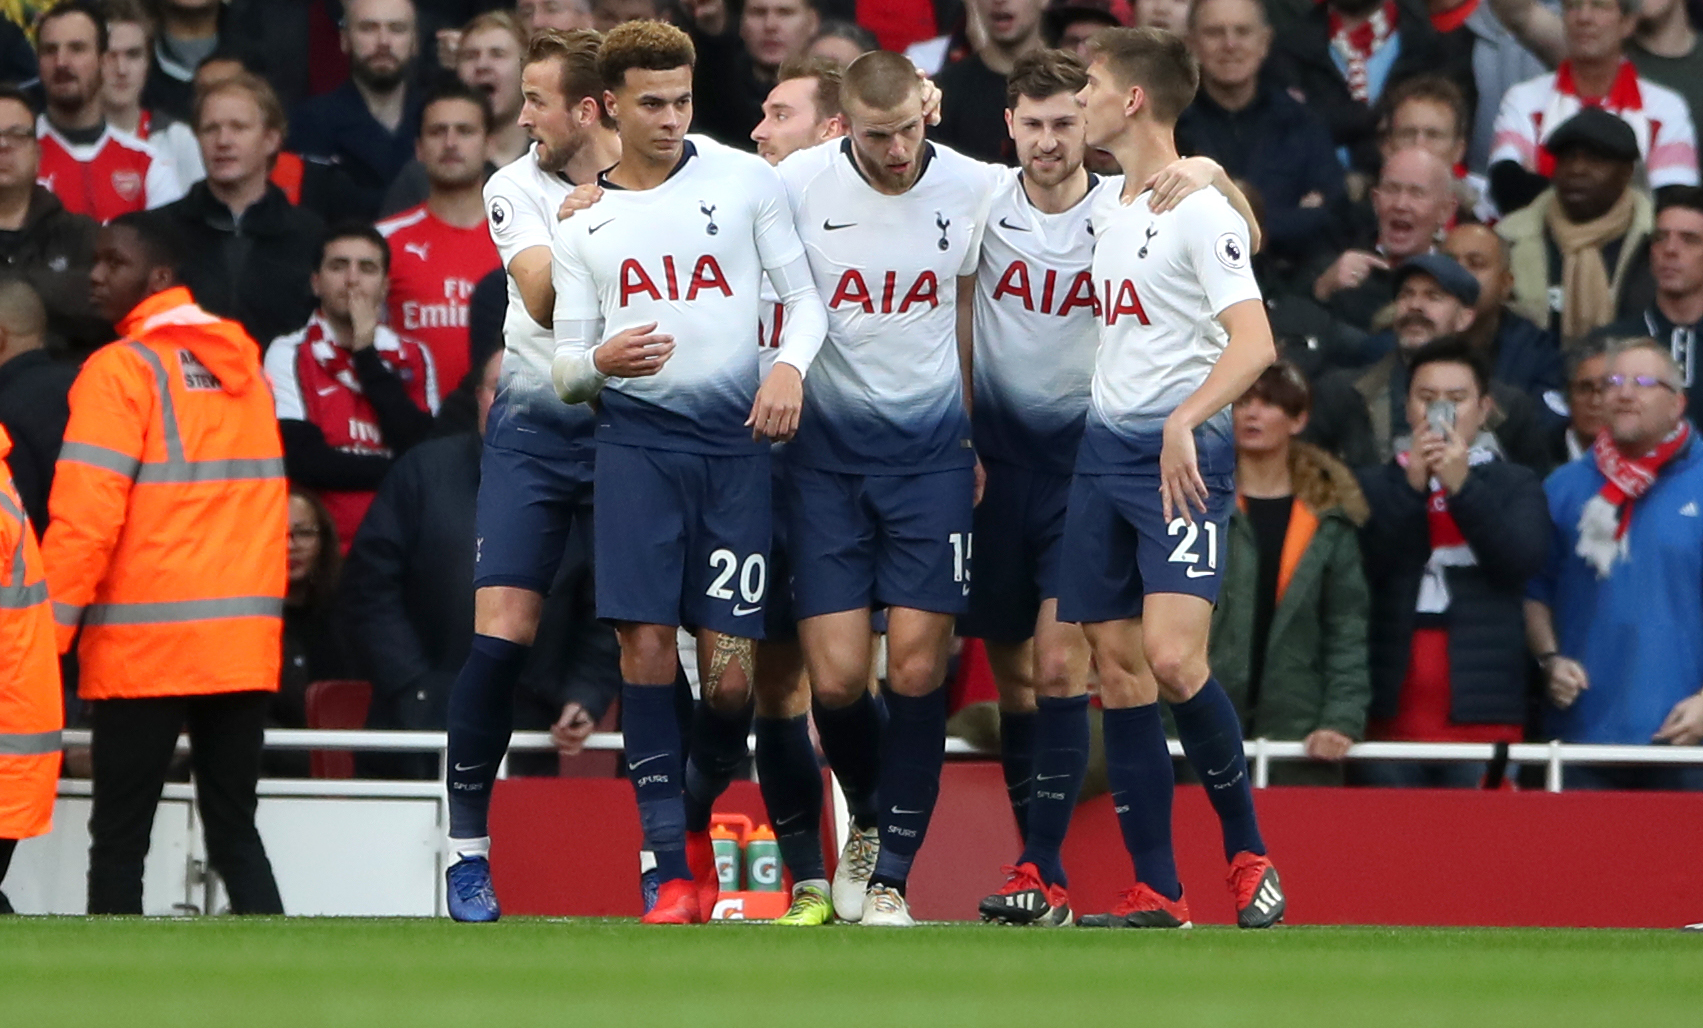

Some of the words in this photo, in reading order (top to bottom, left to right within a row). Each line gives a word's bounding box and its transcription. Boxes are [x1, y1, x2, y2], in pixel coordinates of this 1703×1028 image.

[620, 254, 733, 307] AIA
[829, 269, 939, 313] AIA
[993, 260, 1096, 316] AIA
[402, 300, 471, 330] Emir
[1167, 517, 1217, 570] 21
[705, 548, 766, 604] 20
[452, 781, 484, 792] SPURS
[638, 774, 669, 788] SPURS
[1037, 790, 1066, 801] SPURS
[887, 824, 917, 839] SPURS
[752, 855, 778, 885] G
